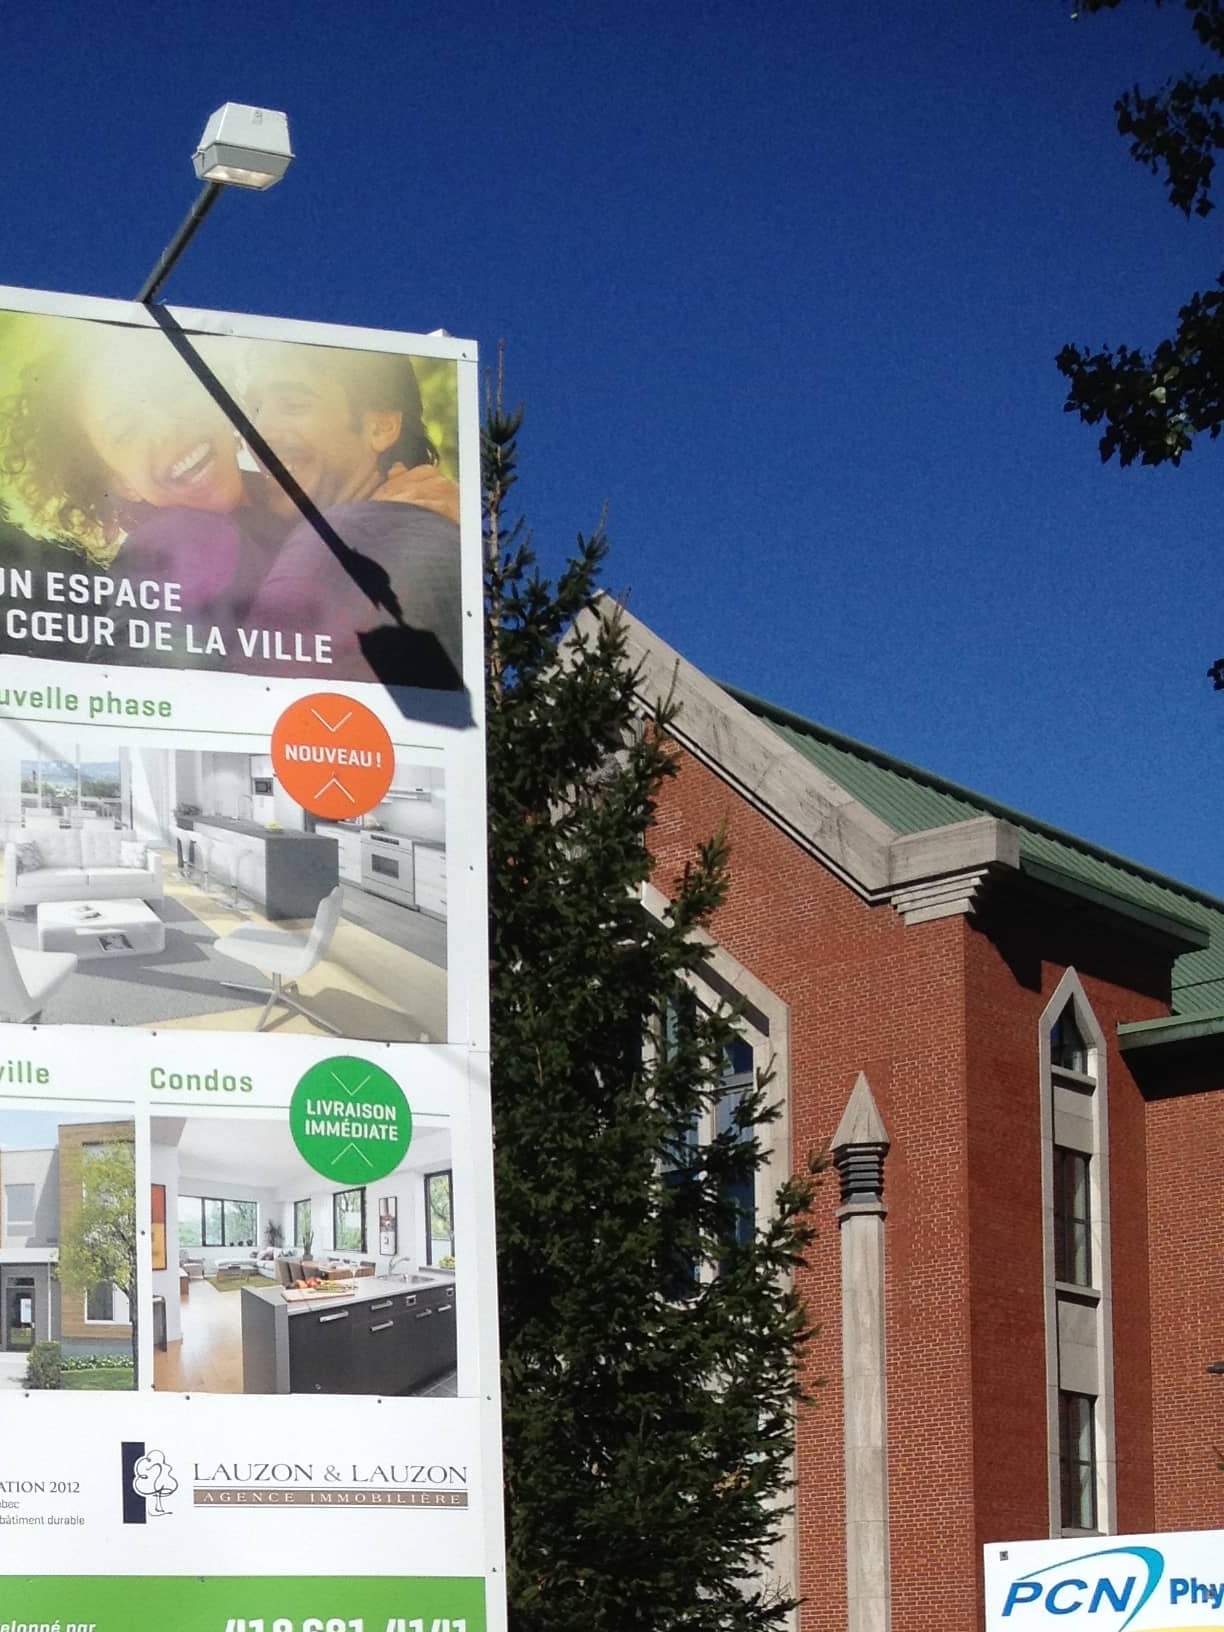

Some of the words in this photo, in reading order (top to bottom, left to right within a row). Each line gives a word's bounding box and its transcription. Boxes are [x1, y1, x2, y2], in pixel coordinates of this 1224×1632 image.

[47, 571, 182, 612] ESPACE
[6, 608, 115, 646] CŒUR
[128, 619, 173, 651] DE
[186, 623, 226, 656] LA
[236, 628, 333, 664] VILLE
[89, 691, 172, 718] phase
[150, 1066, 253, 1093] Condos
[306, 1098, 397, 1121] LIVRAISON
[305, 1119, 399, 1142] IMMÉDIATE
[193, 1463, 314, 1482] LAUZON
[323, 1465, 342, 1482] &
[351, 1465, 468, 1484] LAUZON
[49, 1481, 81, 1494] 2012
[202, 1491, 296, 1503] AGENCE
[309, 1492, 462, 1505] IMMOBILIÈRE
[0, 1514, 45, 1527] bâtiment
[47, 1515, 85, 1527] durable
[1001, 1576, 1137, 1617] PCN
[1169, 1577, 1224, 1609] Phy
